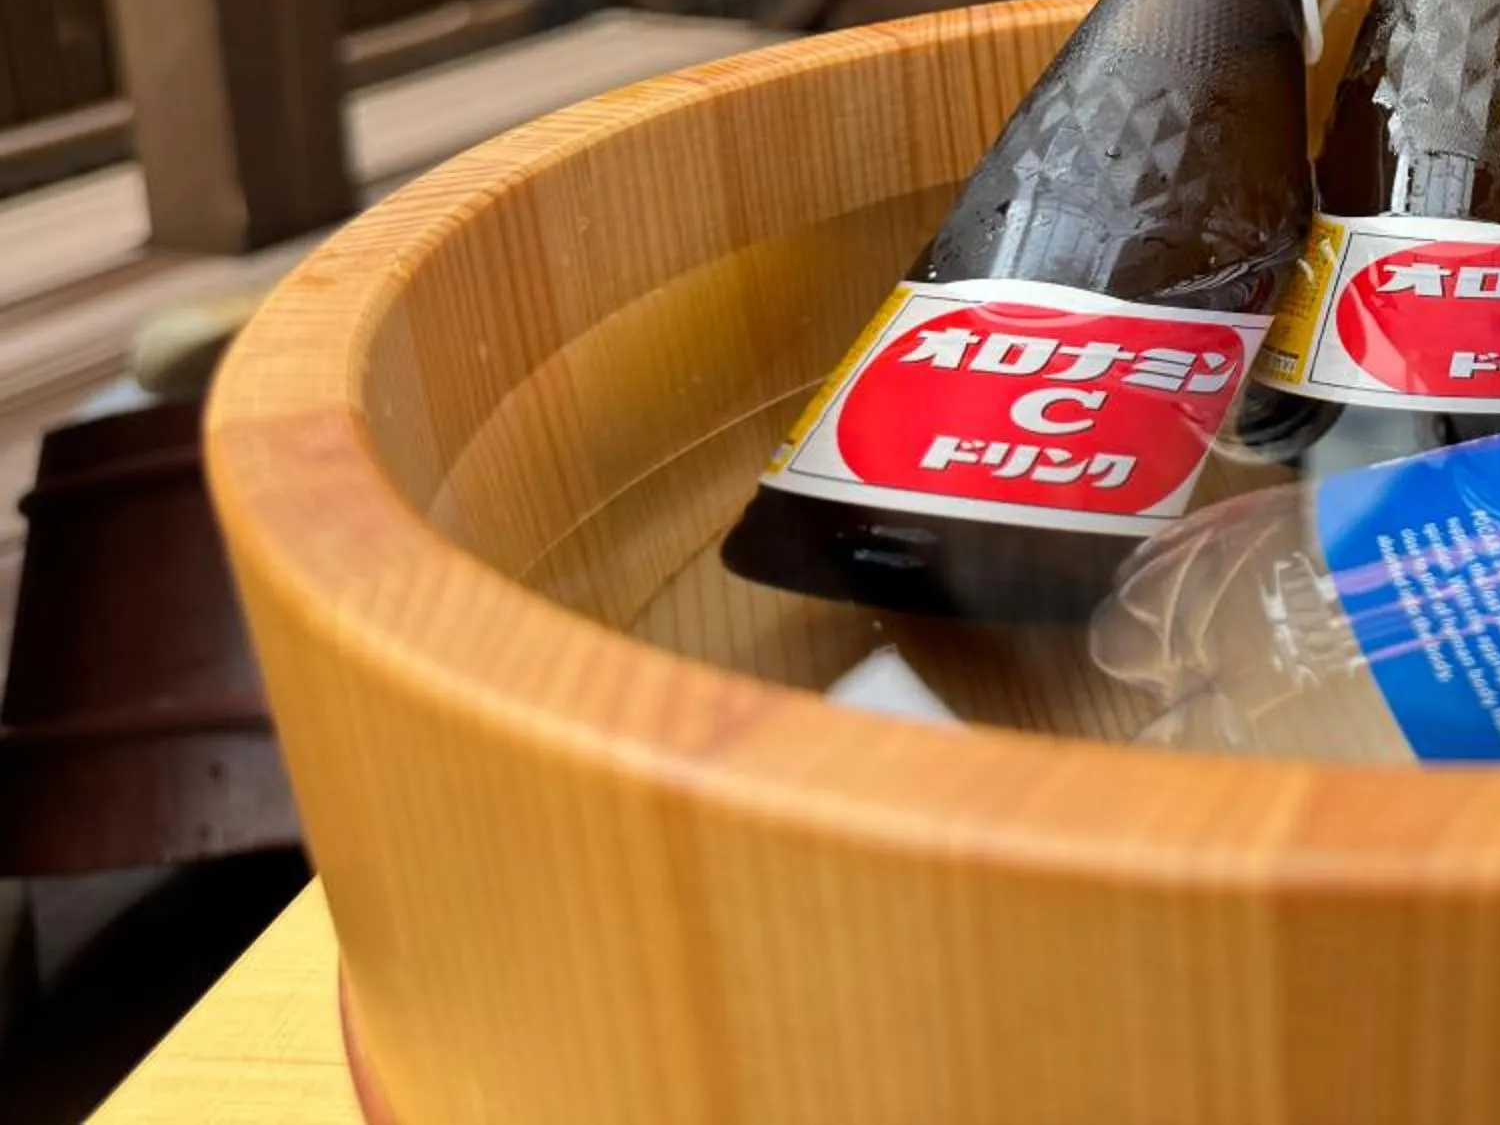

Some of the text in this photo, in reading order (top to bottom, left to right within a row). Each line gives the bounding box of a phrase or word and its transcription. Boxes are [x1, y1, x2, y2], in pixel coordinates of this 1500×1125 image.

[898, 328, 1239, 394] オロナミン
[1009, 388, 1107, 435] C
[919, 435, 1137, 488] ドリンク
